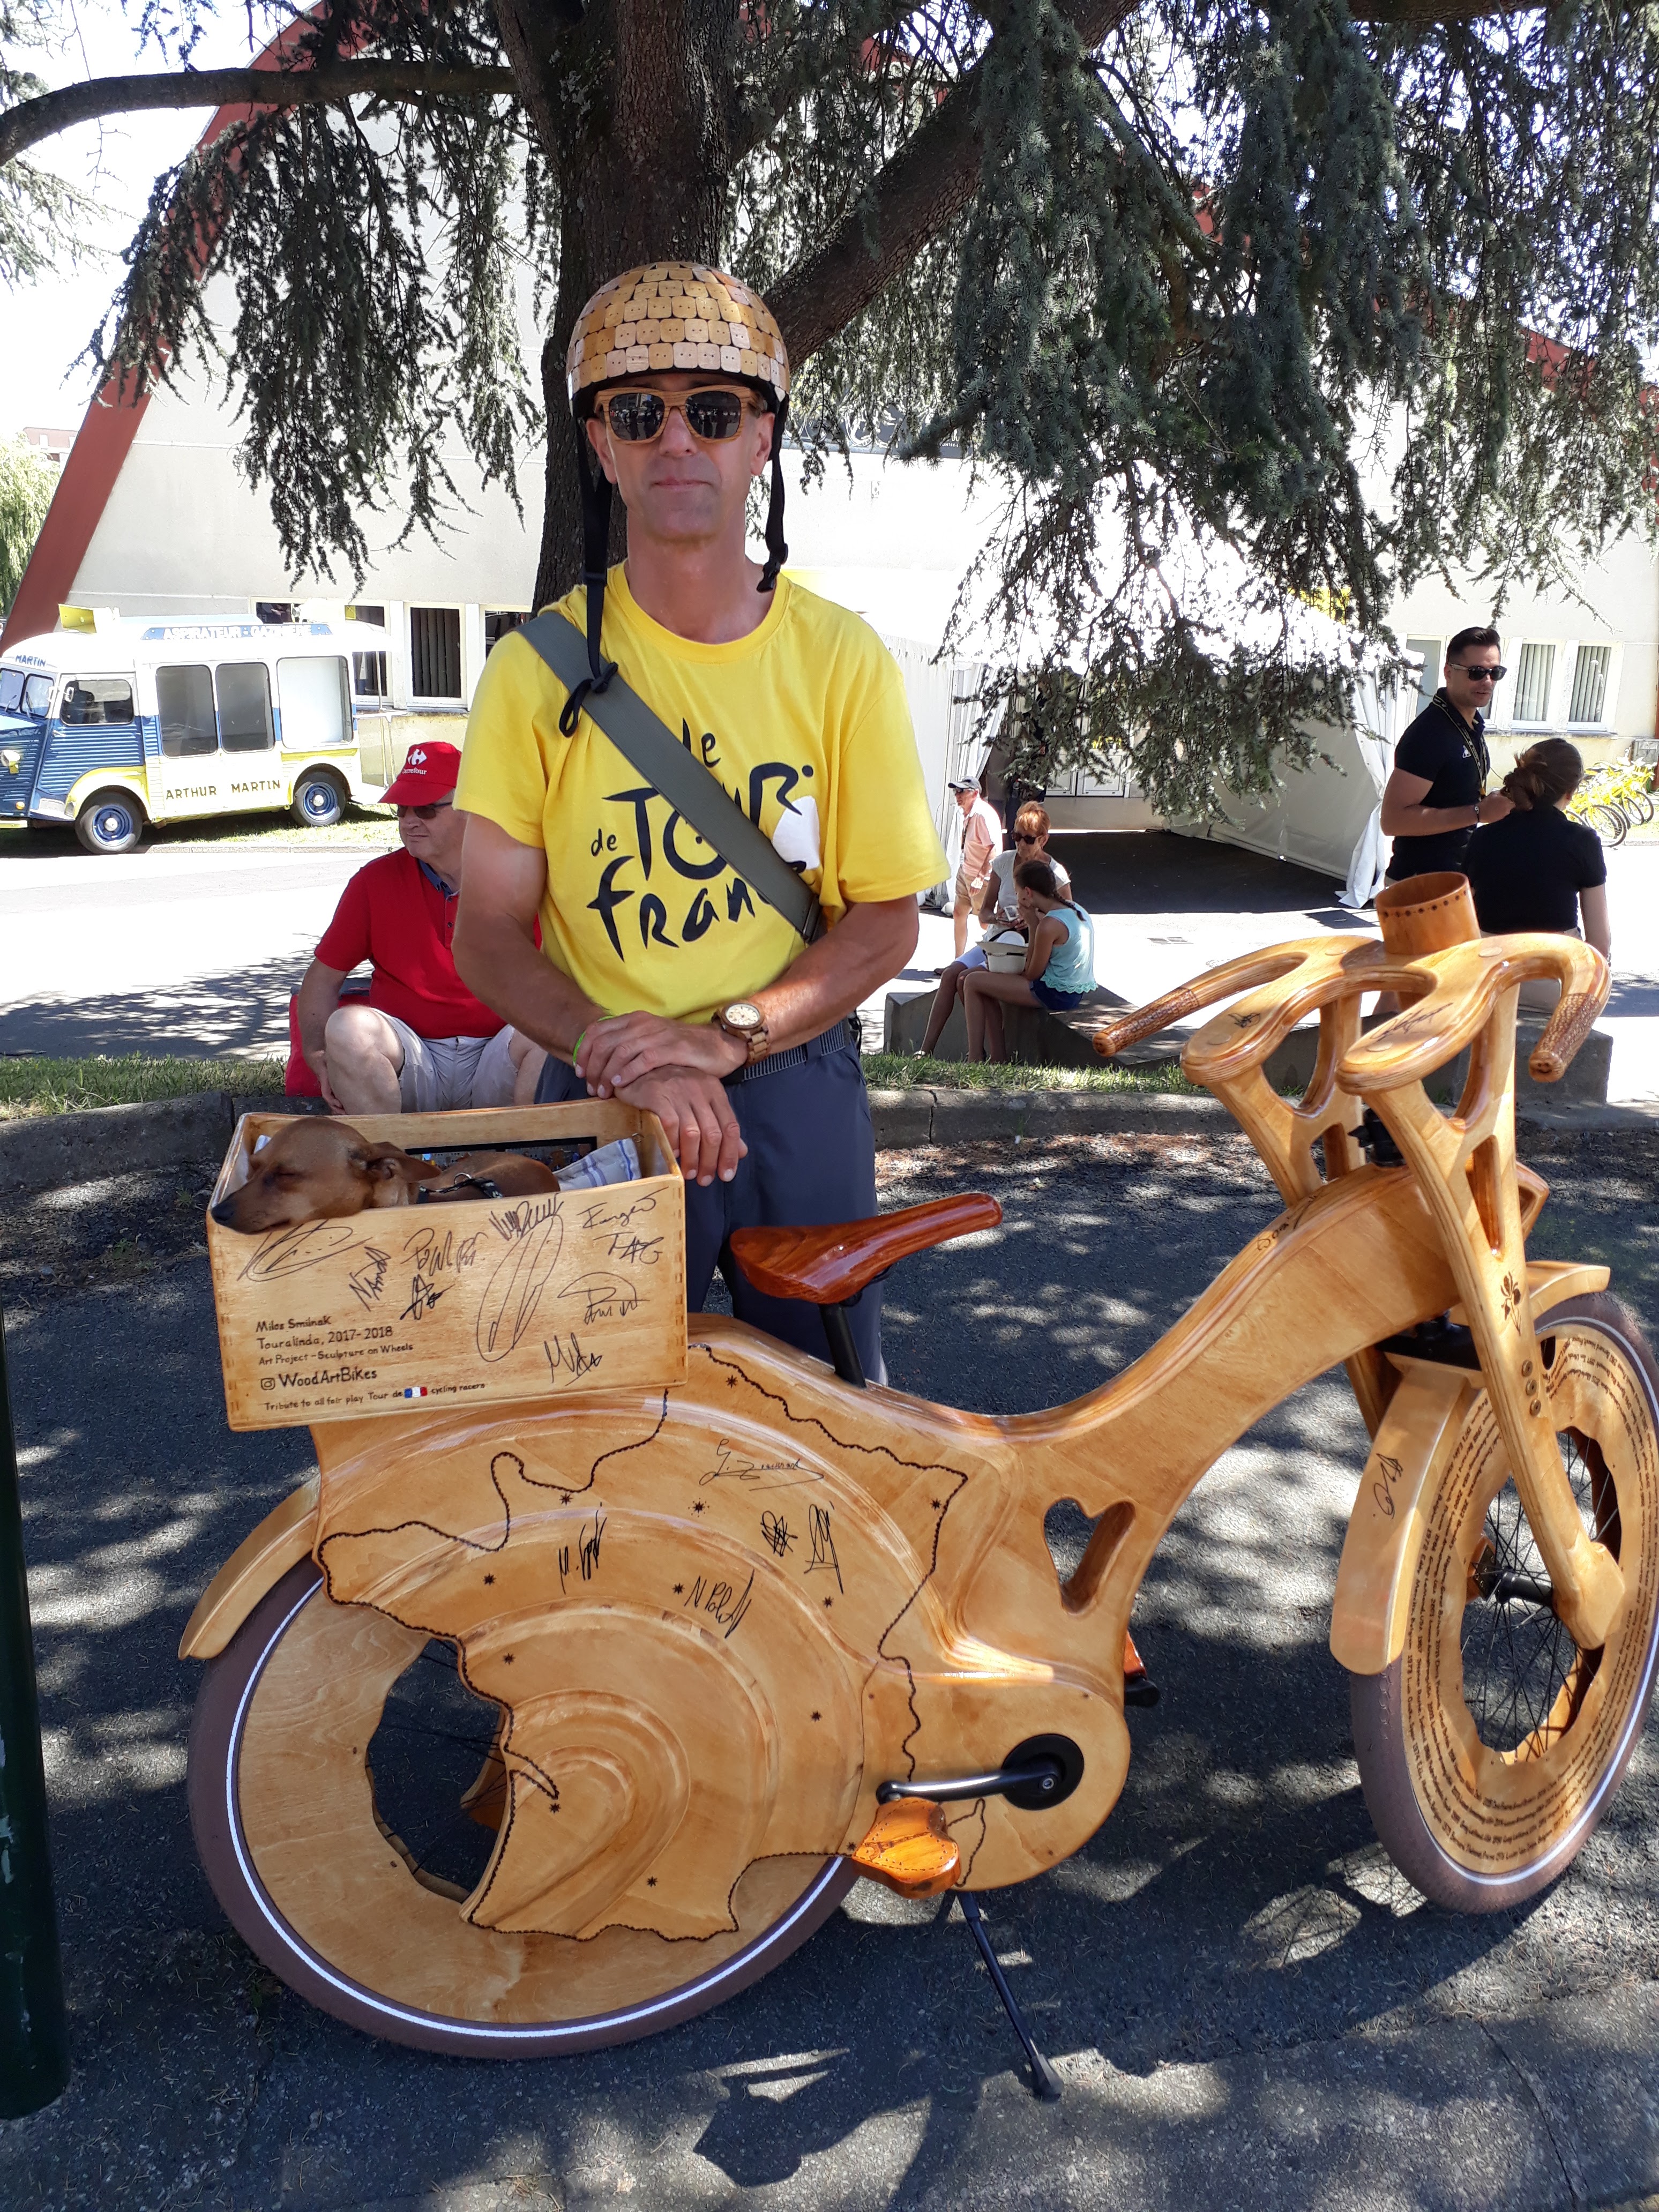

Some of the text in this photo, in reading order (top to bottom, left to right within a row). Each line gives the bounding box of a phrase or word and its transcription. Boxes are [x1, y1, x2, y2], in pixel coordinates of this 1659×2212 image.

[163, 626, 241, 639] ASPIRATEUR
[16, 655, 46, 667] MARTIN
[166, 780, 280, 800] ARTHUR MARTIN
[591, 828, 618, 857] de
[256, 1334, 324, 1349] Touralinda,
[259, 1357, 273, 1366] Art
[380, 1343, 414, 1354] Wheels
[264, 1402, 299, 1411] Tribute
[301, 1399, 311, 1408] to
[326, 1396, 343, 1405] fair
[345, 1394, 364, 1405] play
[368, 1392, 388, 1401] Tour
[392, 1390, 403, 1398] de
[431, 1385, 457, 1394] cycling
[459, 1382, 485, 1392] racers
